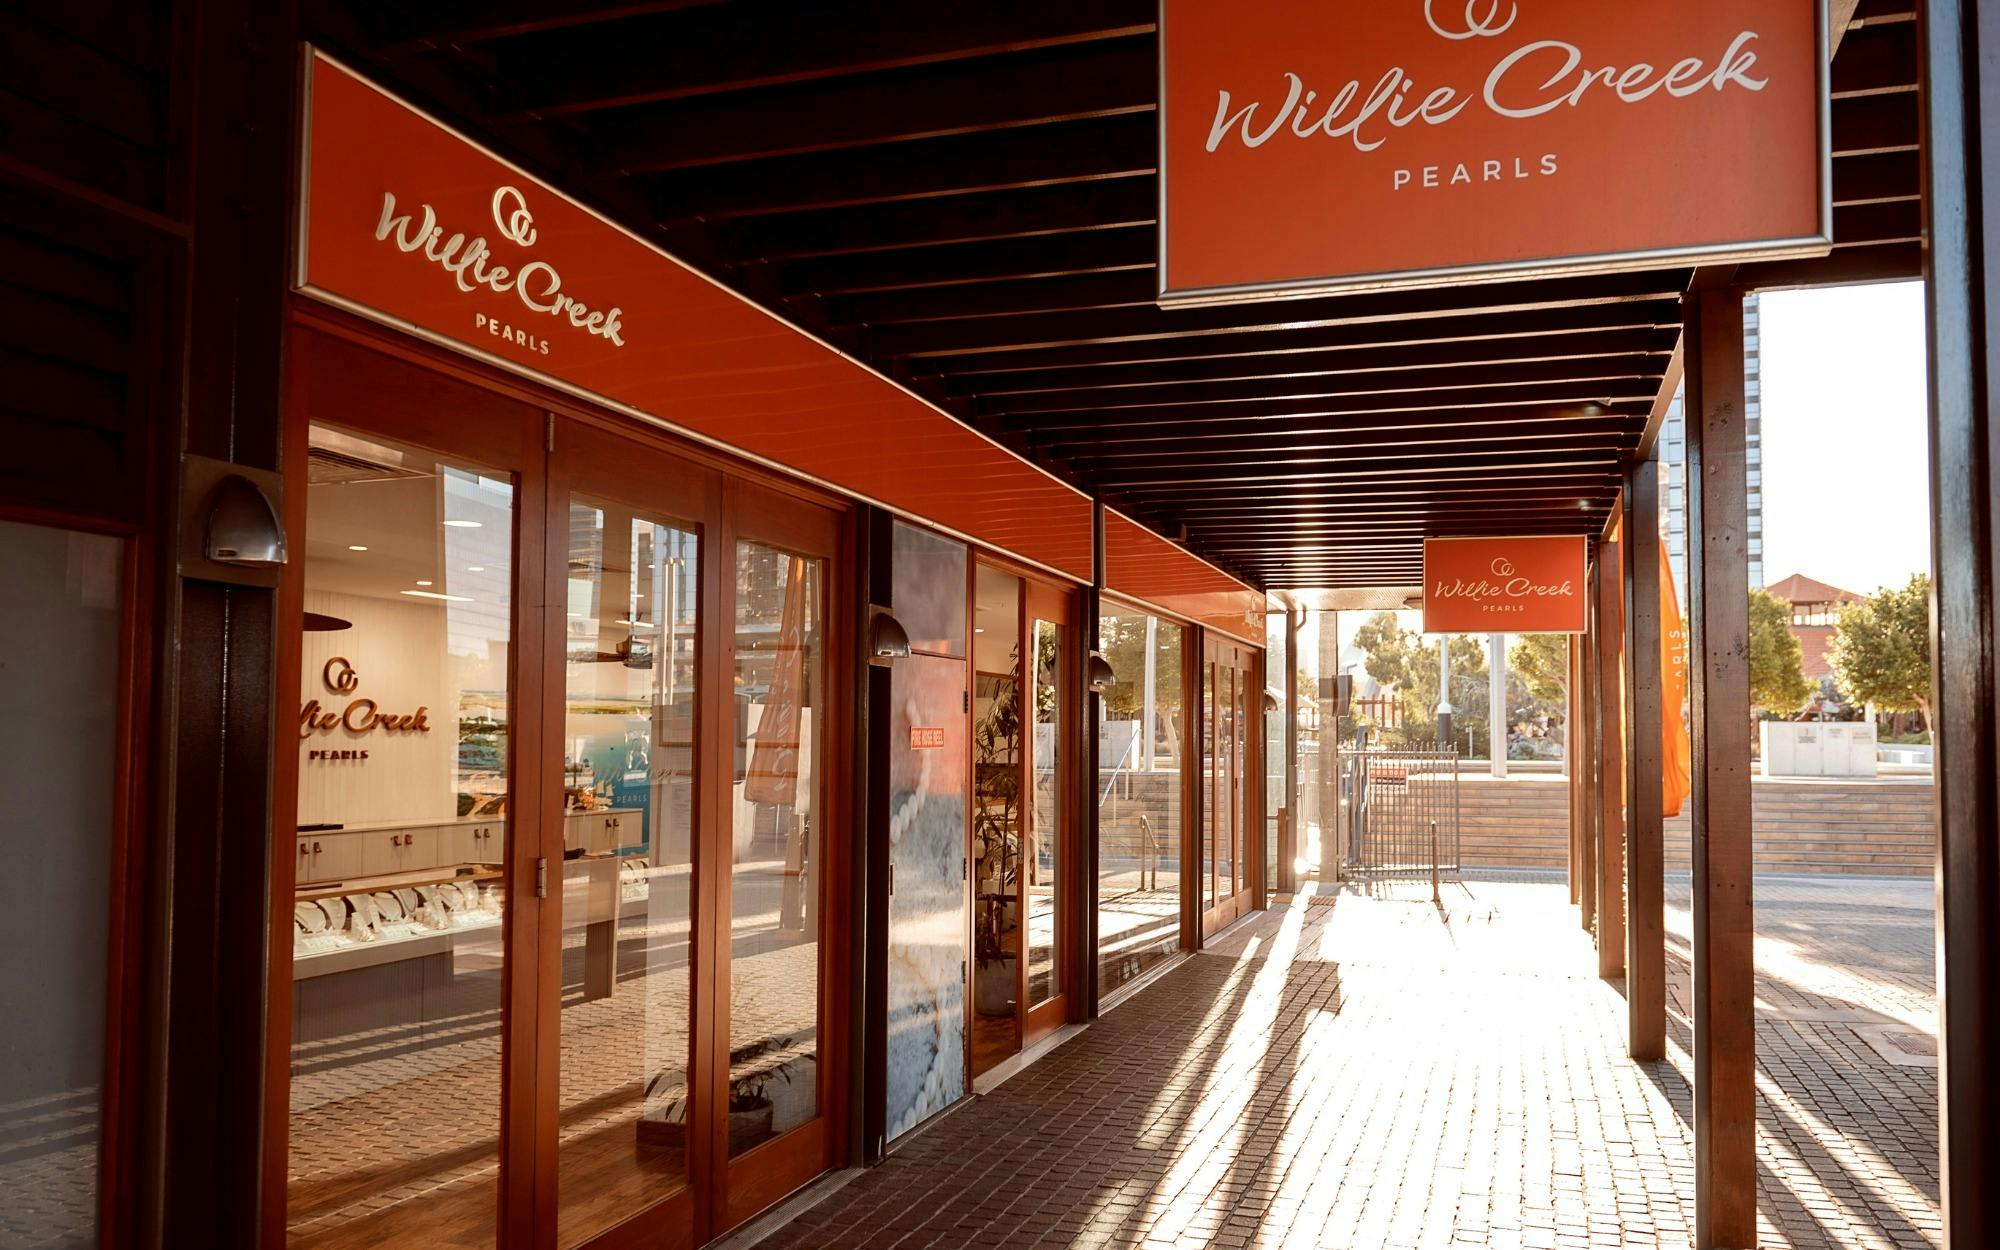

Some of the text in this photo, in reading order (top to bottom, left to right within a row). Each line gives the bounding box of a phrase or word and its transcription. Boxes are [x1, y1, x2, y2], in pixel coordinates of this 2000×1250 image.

[1205, 31, 1768, 153] Willie Creek
[1393, 153, 1558, 190] PEARLS
[375, 191, 626, 347] Willie Creek
[475, 312, 549, 355] PEARLS
[1434, 577, 1574, 602] Willie Creek
[1482, 604, 1524, 612] PEARLS
[342, 698, 431, 734] Creek
[309, 749, 369, 761] PEARLS
[616, 793, 648, 804] PEARLS
